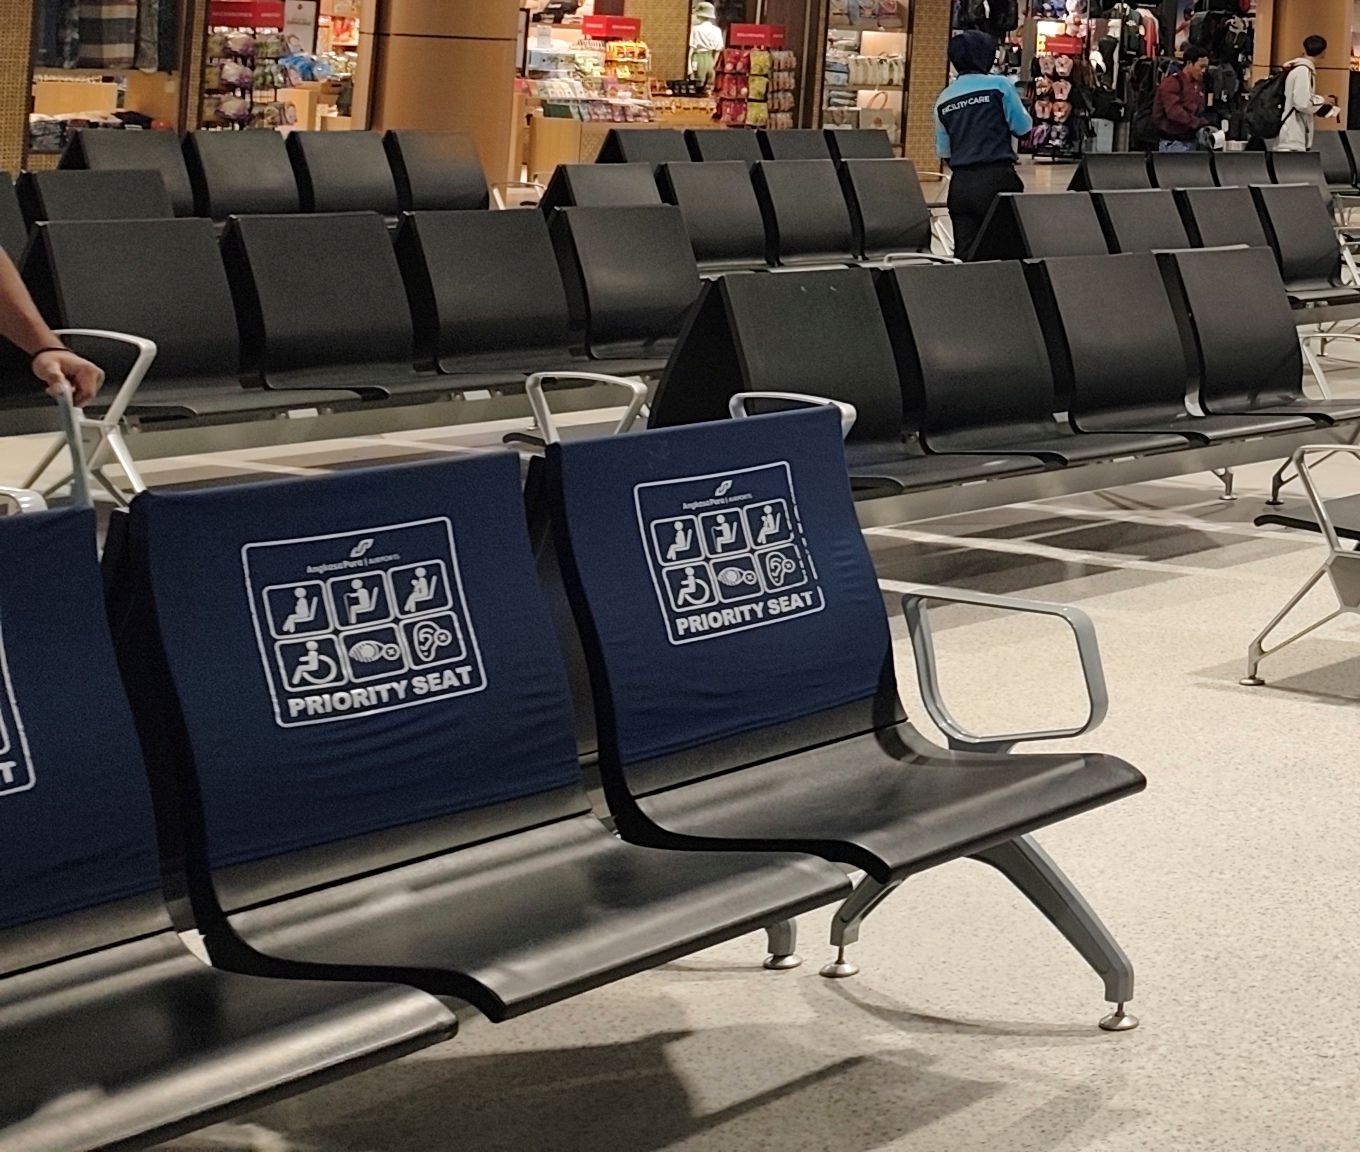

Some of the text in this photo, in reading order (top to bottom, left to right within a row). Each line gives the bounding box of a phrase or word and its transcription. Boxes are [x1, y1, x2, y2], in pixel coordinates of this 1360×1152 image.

[968, 95, 990, 105] CARE
[675, 590, 813, 636] PRIORITY SEAT
[287, 665, 472, 718] PRIORITY SEAT
